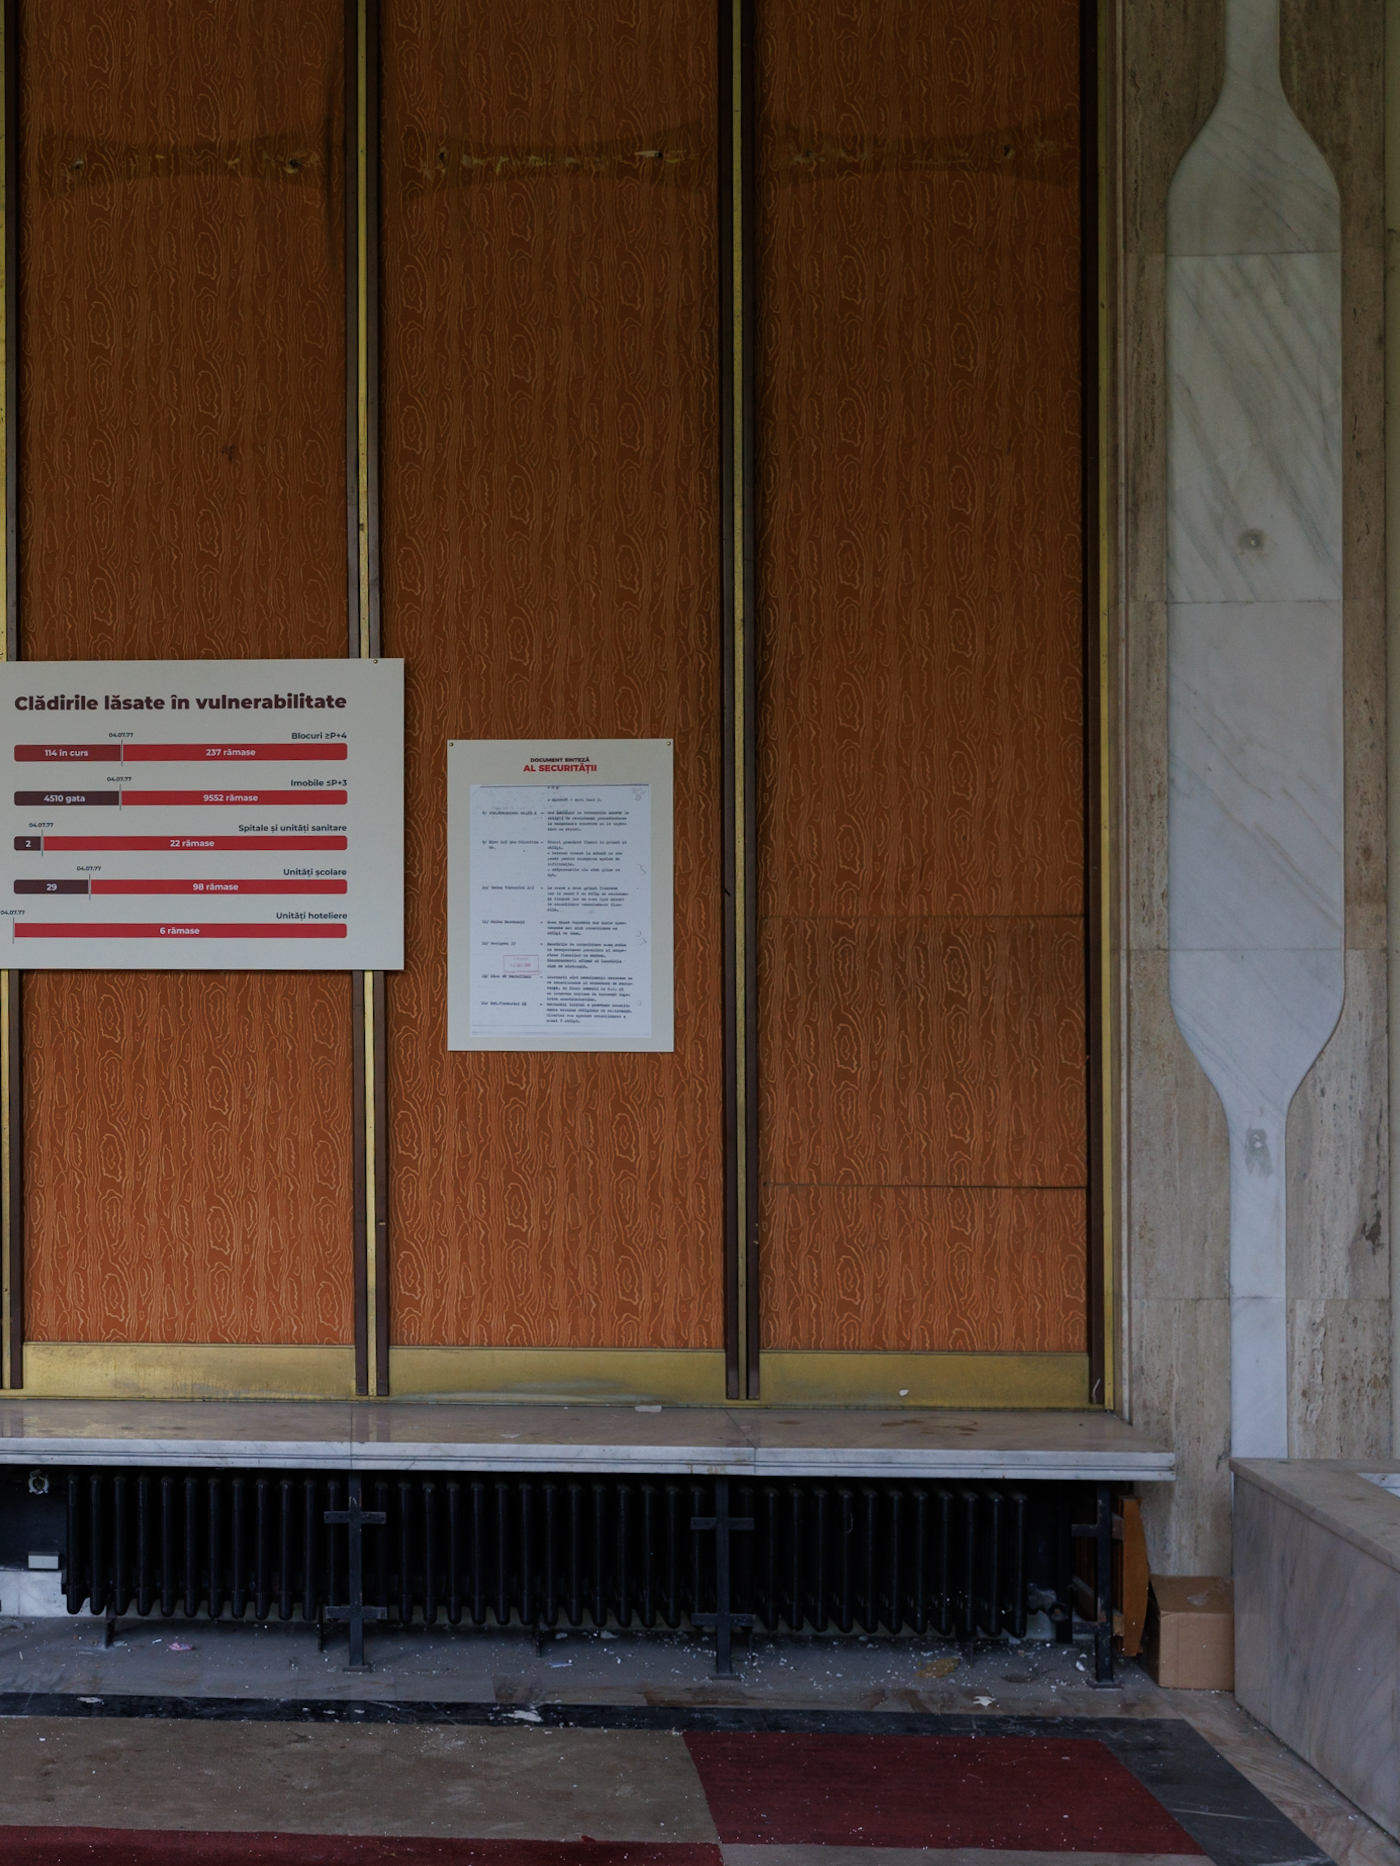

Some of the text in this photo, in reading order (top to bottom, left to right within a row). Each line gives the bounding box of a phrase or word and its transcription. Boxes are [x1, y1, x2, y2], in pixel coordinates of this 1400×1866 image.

[15, 693, 347, 711] Clădirile lăsate în vulnerabilitate
[539, 763, 597, 774] SECURITĂȚII
[66, 795, 85, 804] gata
[238, 824, 269, 833] Spitale
[271, 824, 278, 833] și
[280, 824, 309, 833] unități
[283, 868, 347, 877] Unități școlare
[276, 912, 306, 920] Unități
